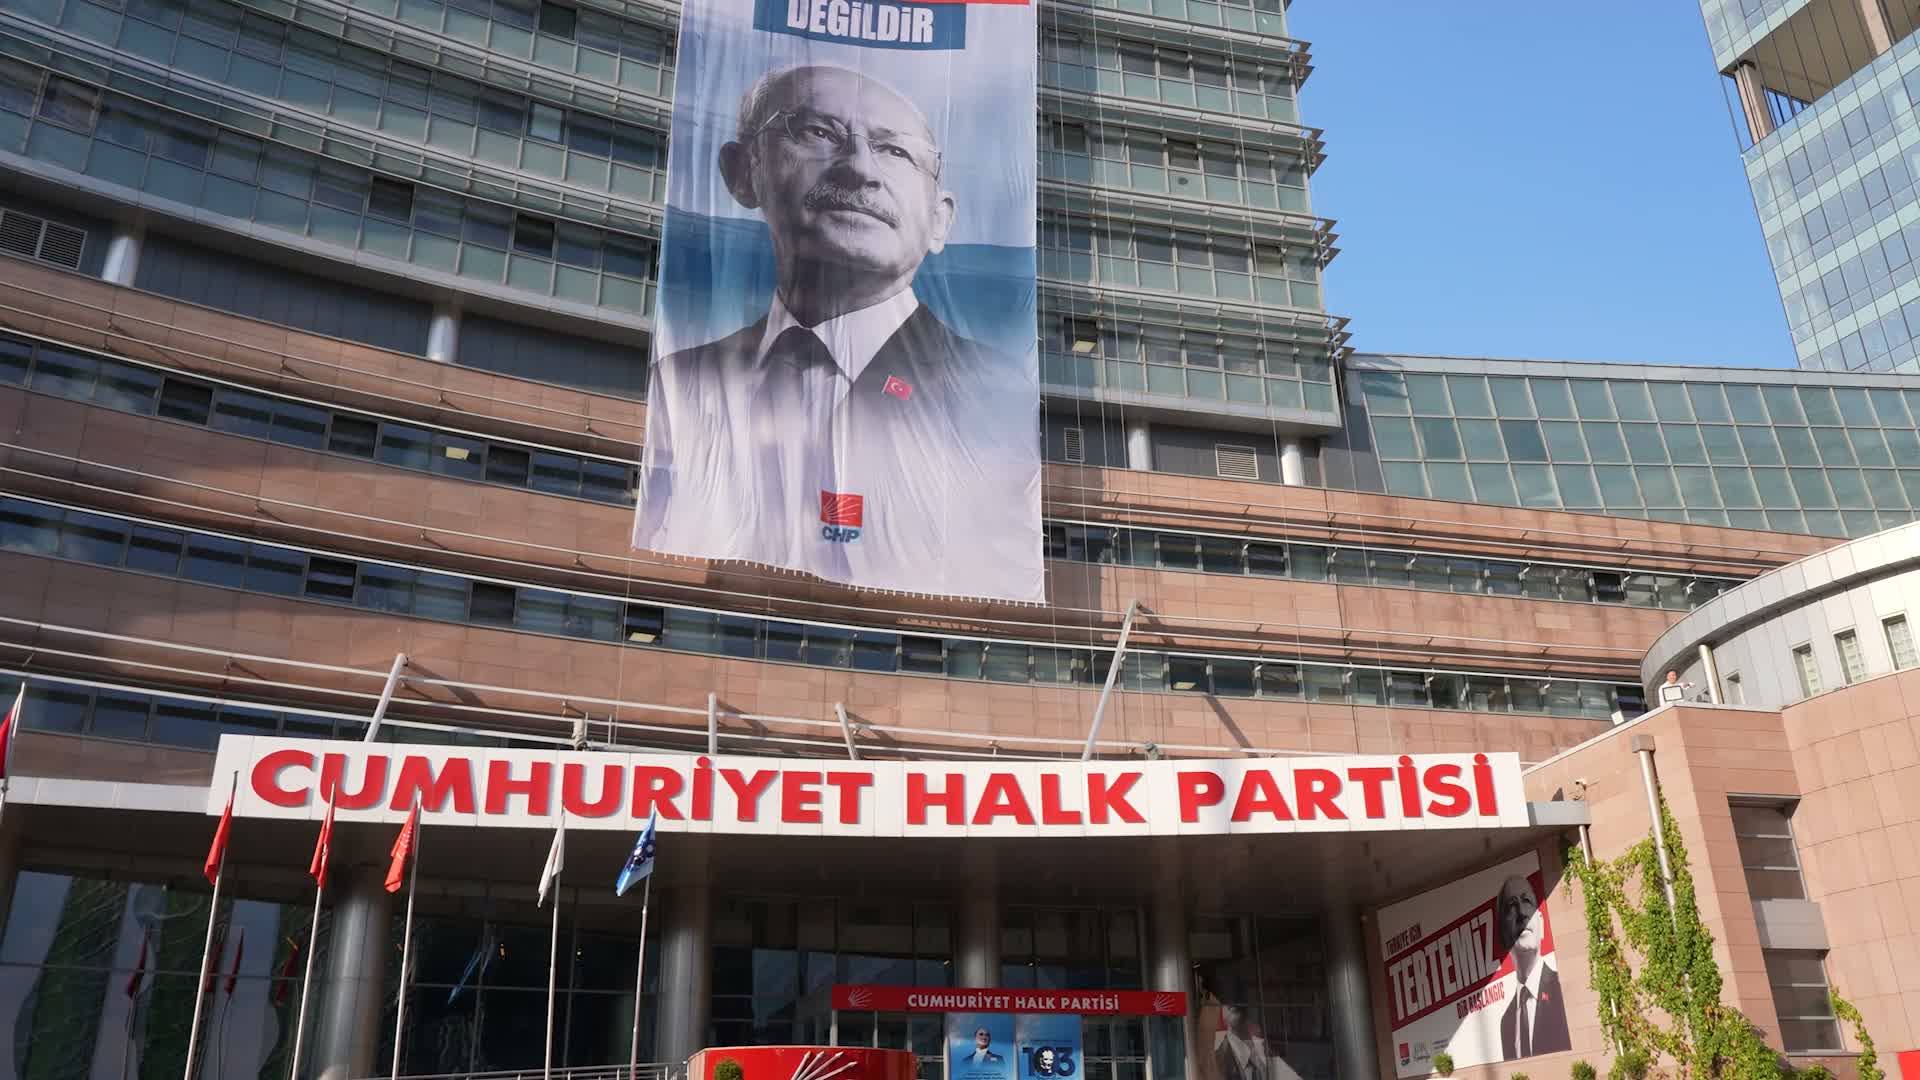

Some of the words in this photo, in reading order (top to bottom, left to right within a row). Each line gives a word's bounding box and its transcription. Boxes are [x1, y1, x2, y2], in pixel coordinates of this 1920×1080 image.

[822, 526, 859, 542] CHP
[251, 756, 873, 824] CUMHURİYET
[906, 773, 1147, 825] HALK
[1177, 754, 1498, 822] PARTİSİ
[1389, 909, 1501, 1022] TERTEMİZ
[907, 992, 1010, 1010] CUMHURİYET
[1015, 997, 1056, 1010] HALK
[1061, 994, 1120, 1011] PARTİSİ
